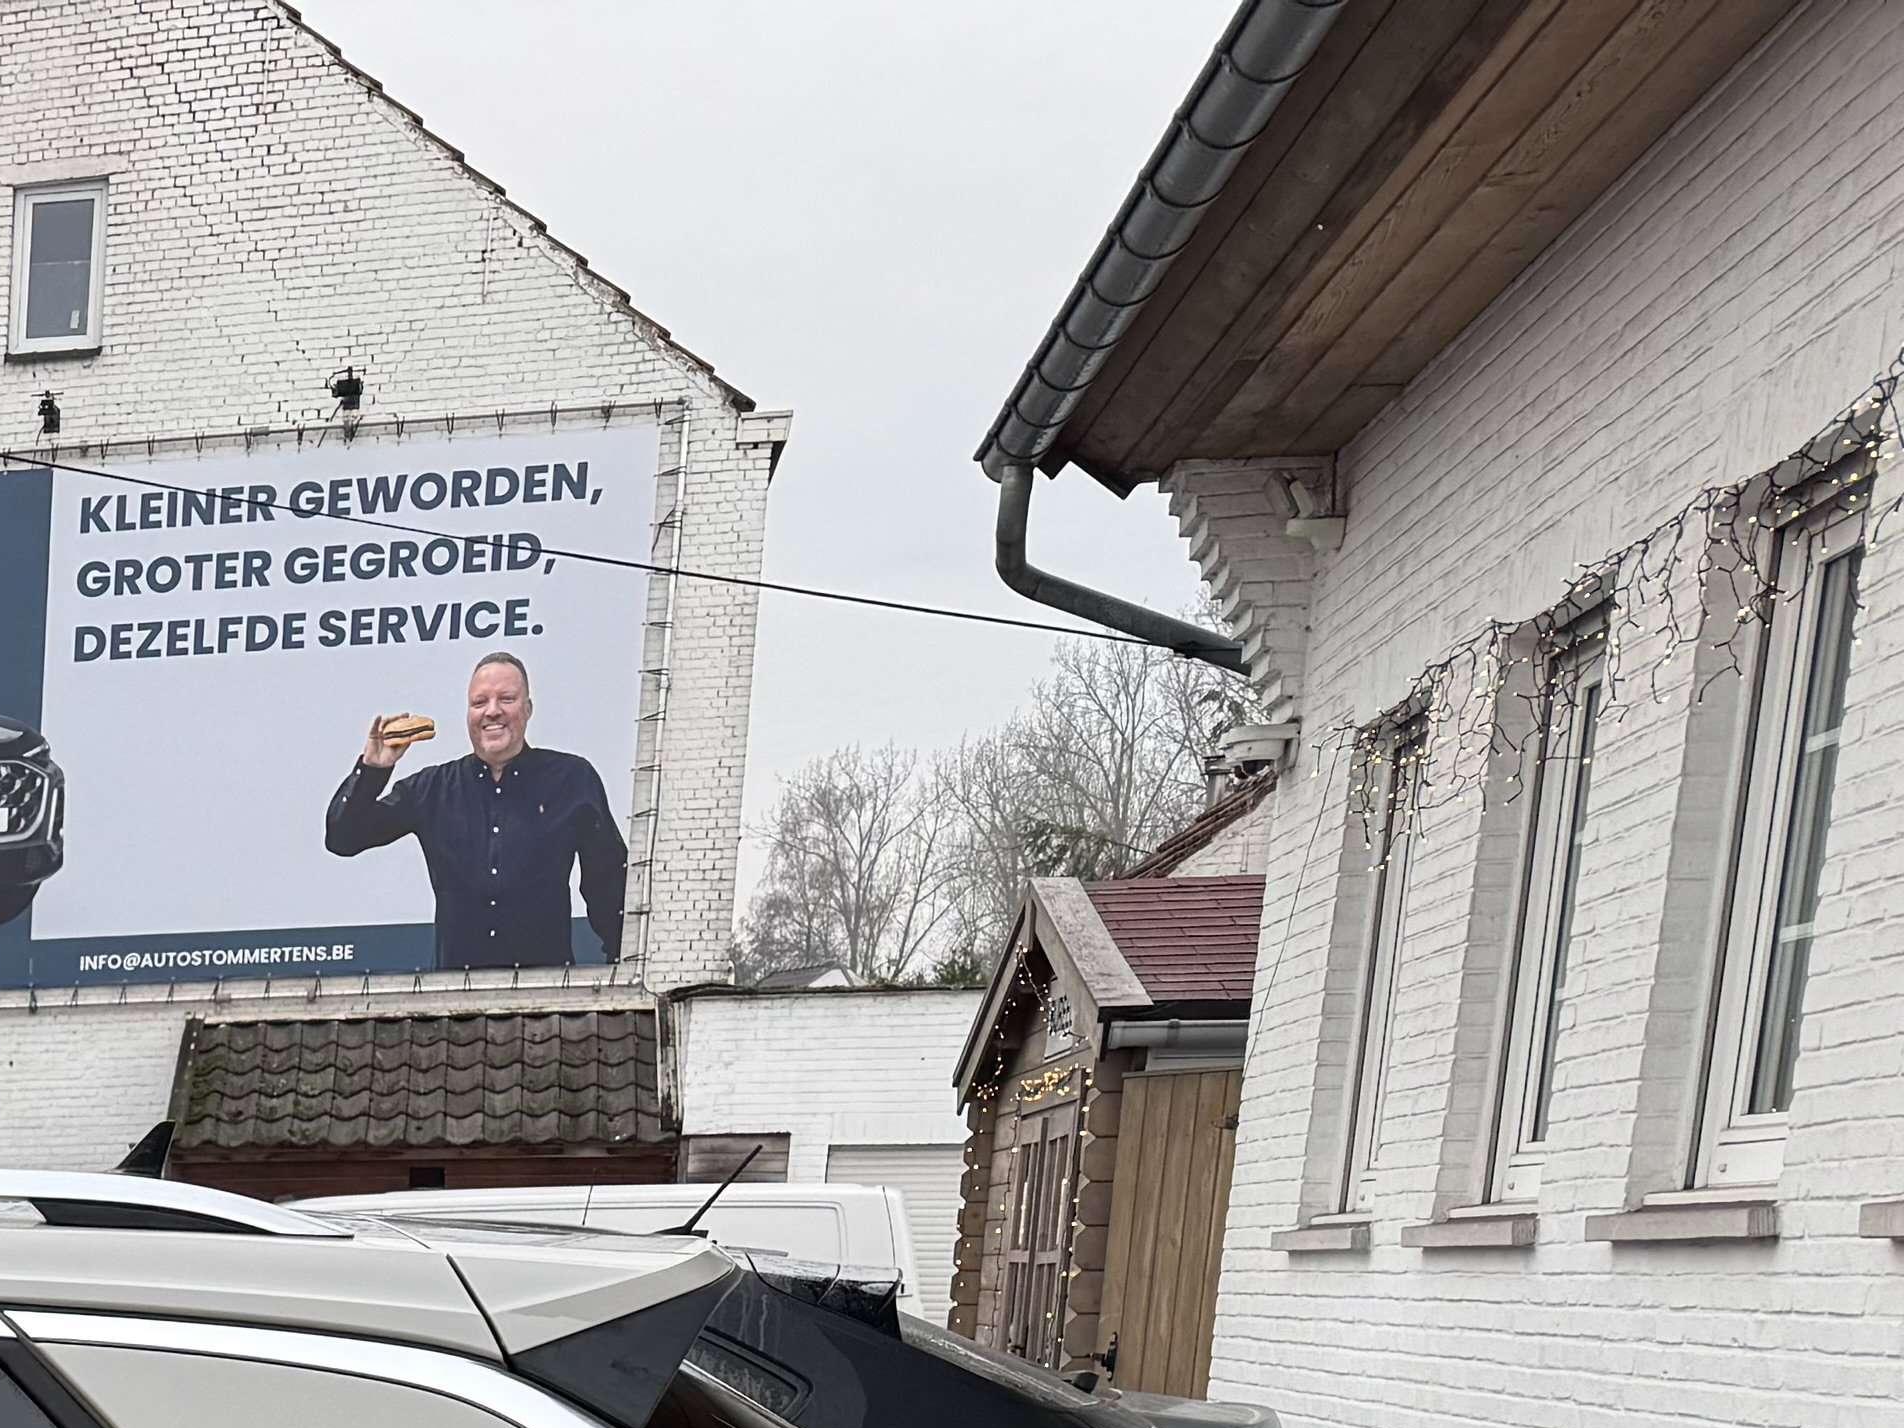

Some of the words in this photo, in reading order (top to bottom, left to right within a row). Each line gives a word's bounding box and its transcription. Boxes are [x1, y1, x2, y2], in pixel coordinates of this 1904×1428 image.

[79, 484, 277, 534] KLEINER
[289, 461, 603, 520] GEWORDEN,
[76, 550, 272, 598] GROTER
[284, 532, 556, 585] GEGROEID,
[74, 612, 307, 662] DEZELFDE
[318, 598, 544, 648] SERVICE.
[80, 944, 355, 971] INFO@AUTOSTOMMERTENS.BE
